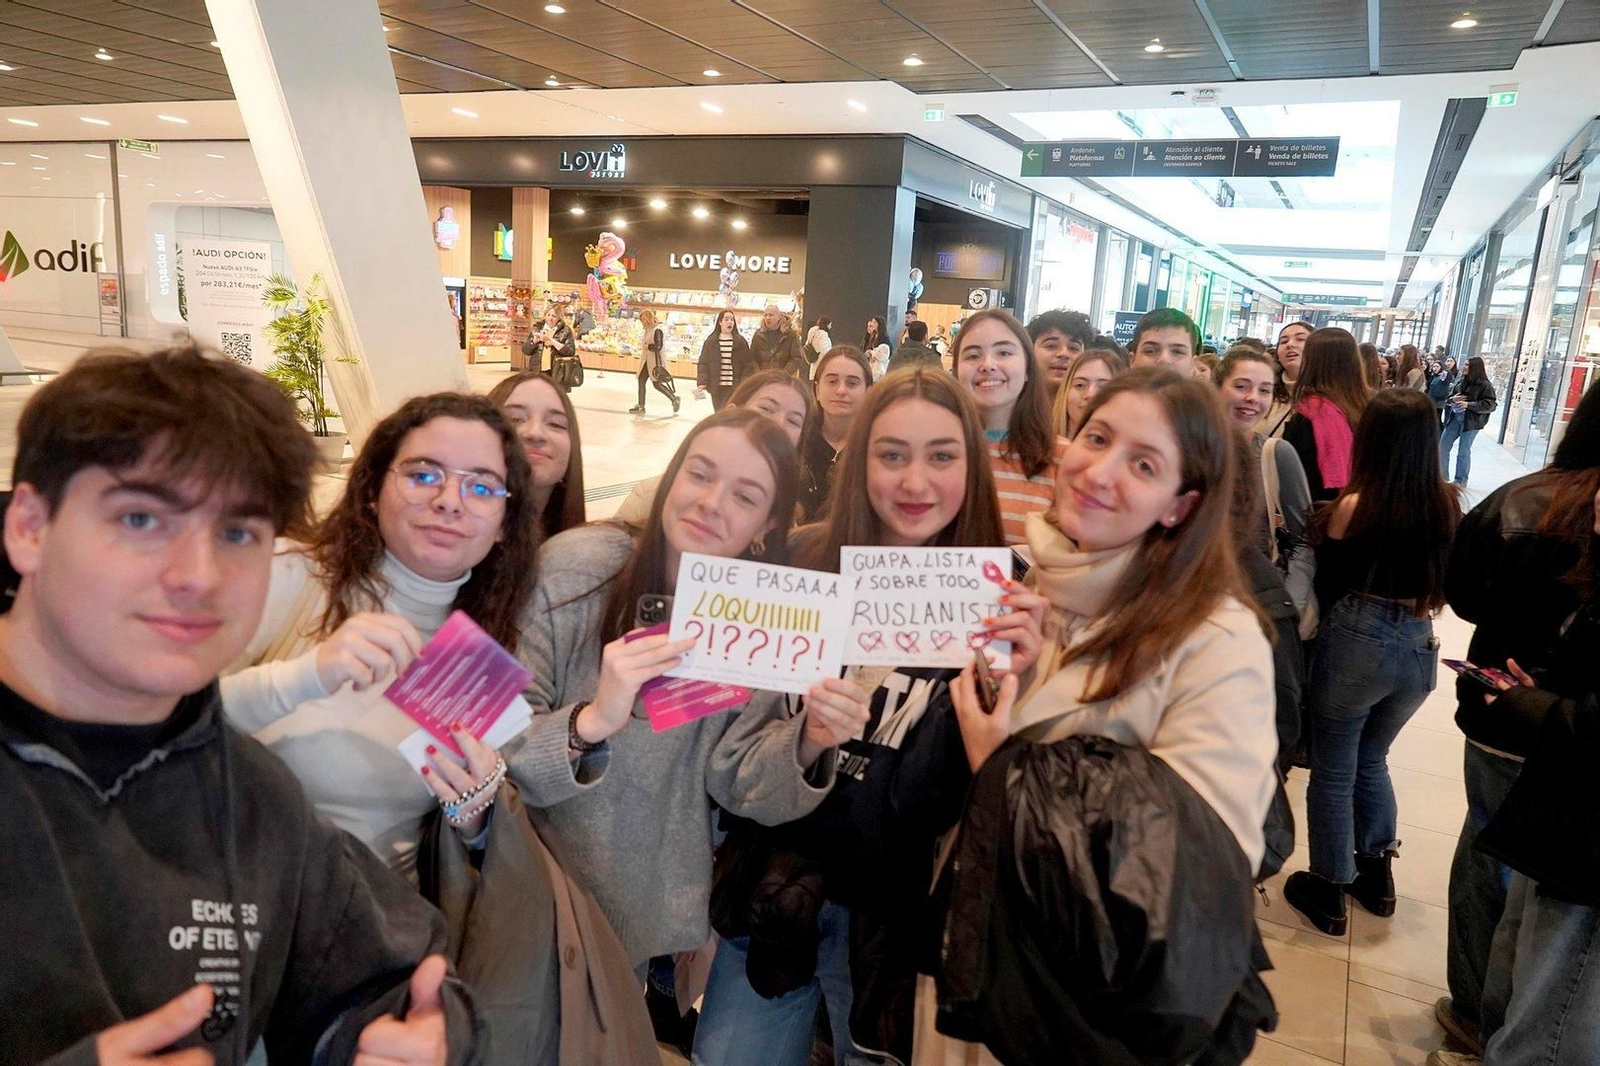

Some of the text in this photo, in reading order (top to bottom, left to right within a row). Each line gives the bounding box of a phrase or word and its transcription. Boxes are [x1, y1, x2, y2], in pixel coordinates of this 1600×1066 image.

[33, 239, 103, 273] adif
[669, 253, 790, 273] LOVE MORE
[924, 552, 976, 569] LISTA
[690, 561, 838, 598] QUE PASAAA
[869, 574, 927, 591] SOBRE
[935, 573, 980, 590] TODO
[168, 925, 200, 950] OF
